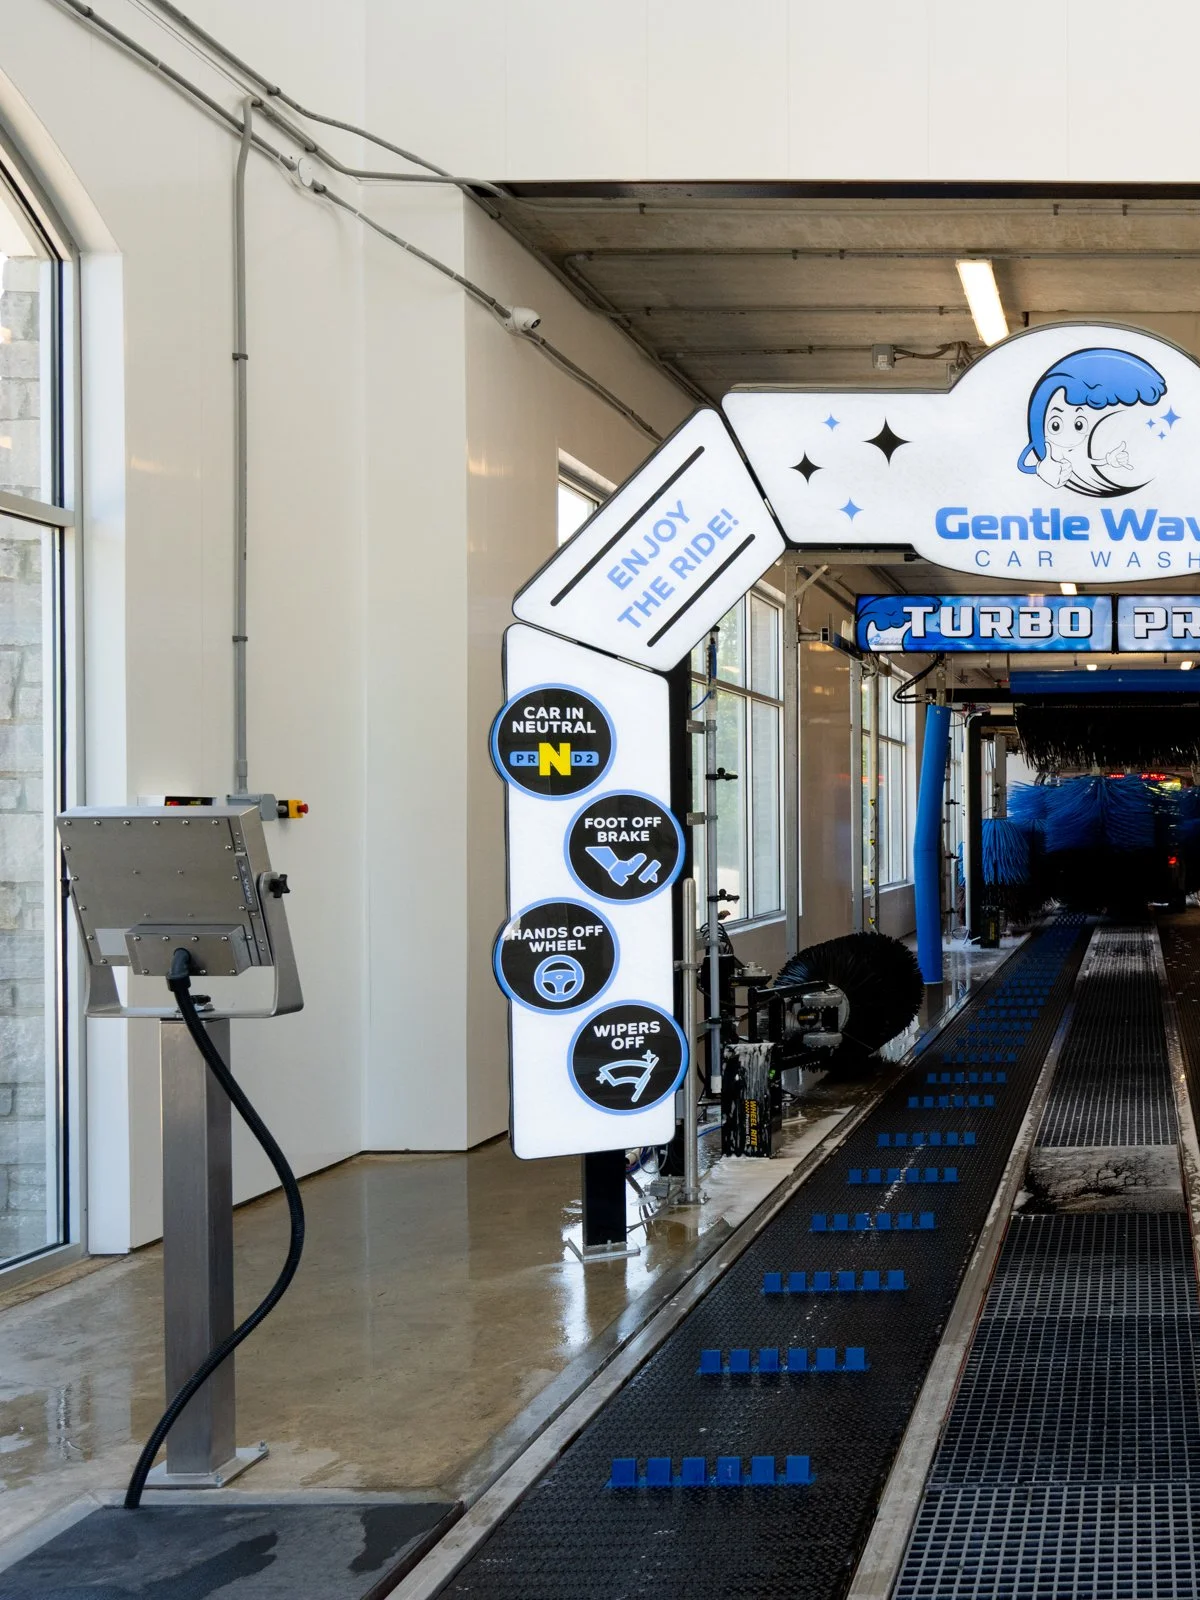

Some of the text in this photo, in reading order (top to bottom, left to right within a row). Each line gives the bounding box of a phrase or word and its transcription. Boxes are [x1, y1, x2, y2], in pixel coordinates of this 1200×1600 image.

[935, 506, 1091, 541] Gentle
[606, 499, 690, 591] ENJOY
[974, 550, 1053, 568] CAR
[616, 507, 740, 629] THE RIDE!
[902, 606, 1093, 639] TURBO
[523, 706, 584, 720] CAR IN
[512, 720, 597, 734] NEUTRAL
[584, 816, 662, 829] FOOT OFF
[597, 830, 650, 843] BRAKE
[510, 925, 604, 941] HANDS OFF
[528, 939, 587, 953] WHEEL
[593, 1020, 661, 1038] WIPERS
[611, 1035, 645, 1051] OFF
[750, 1128, 758, 1147] RITE
